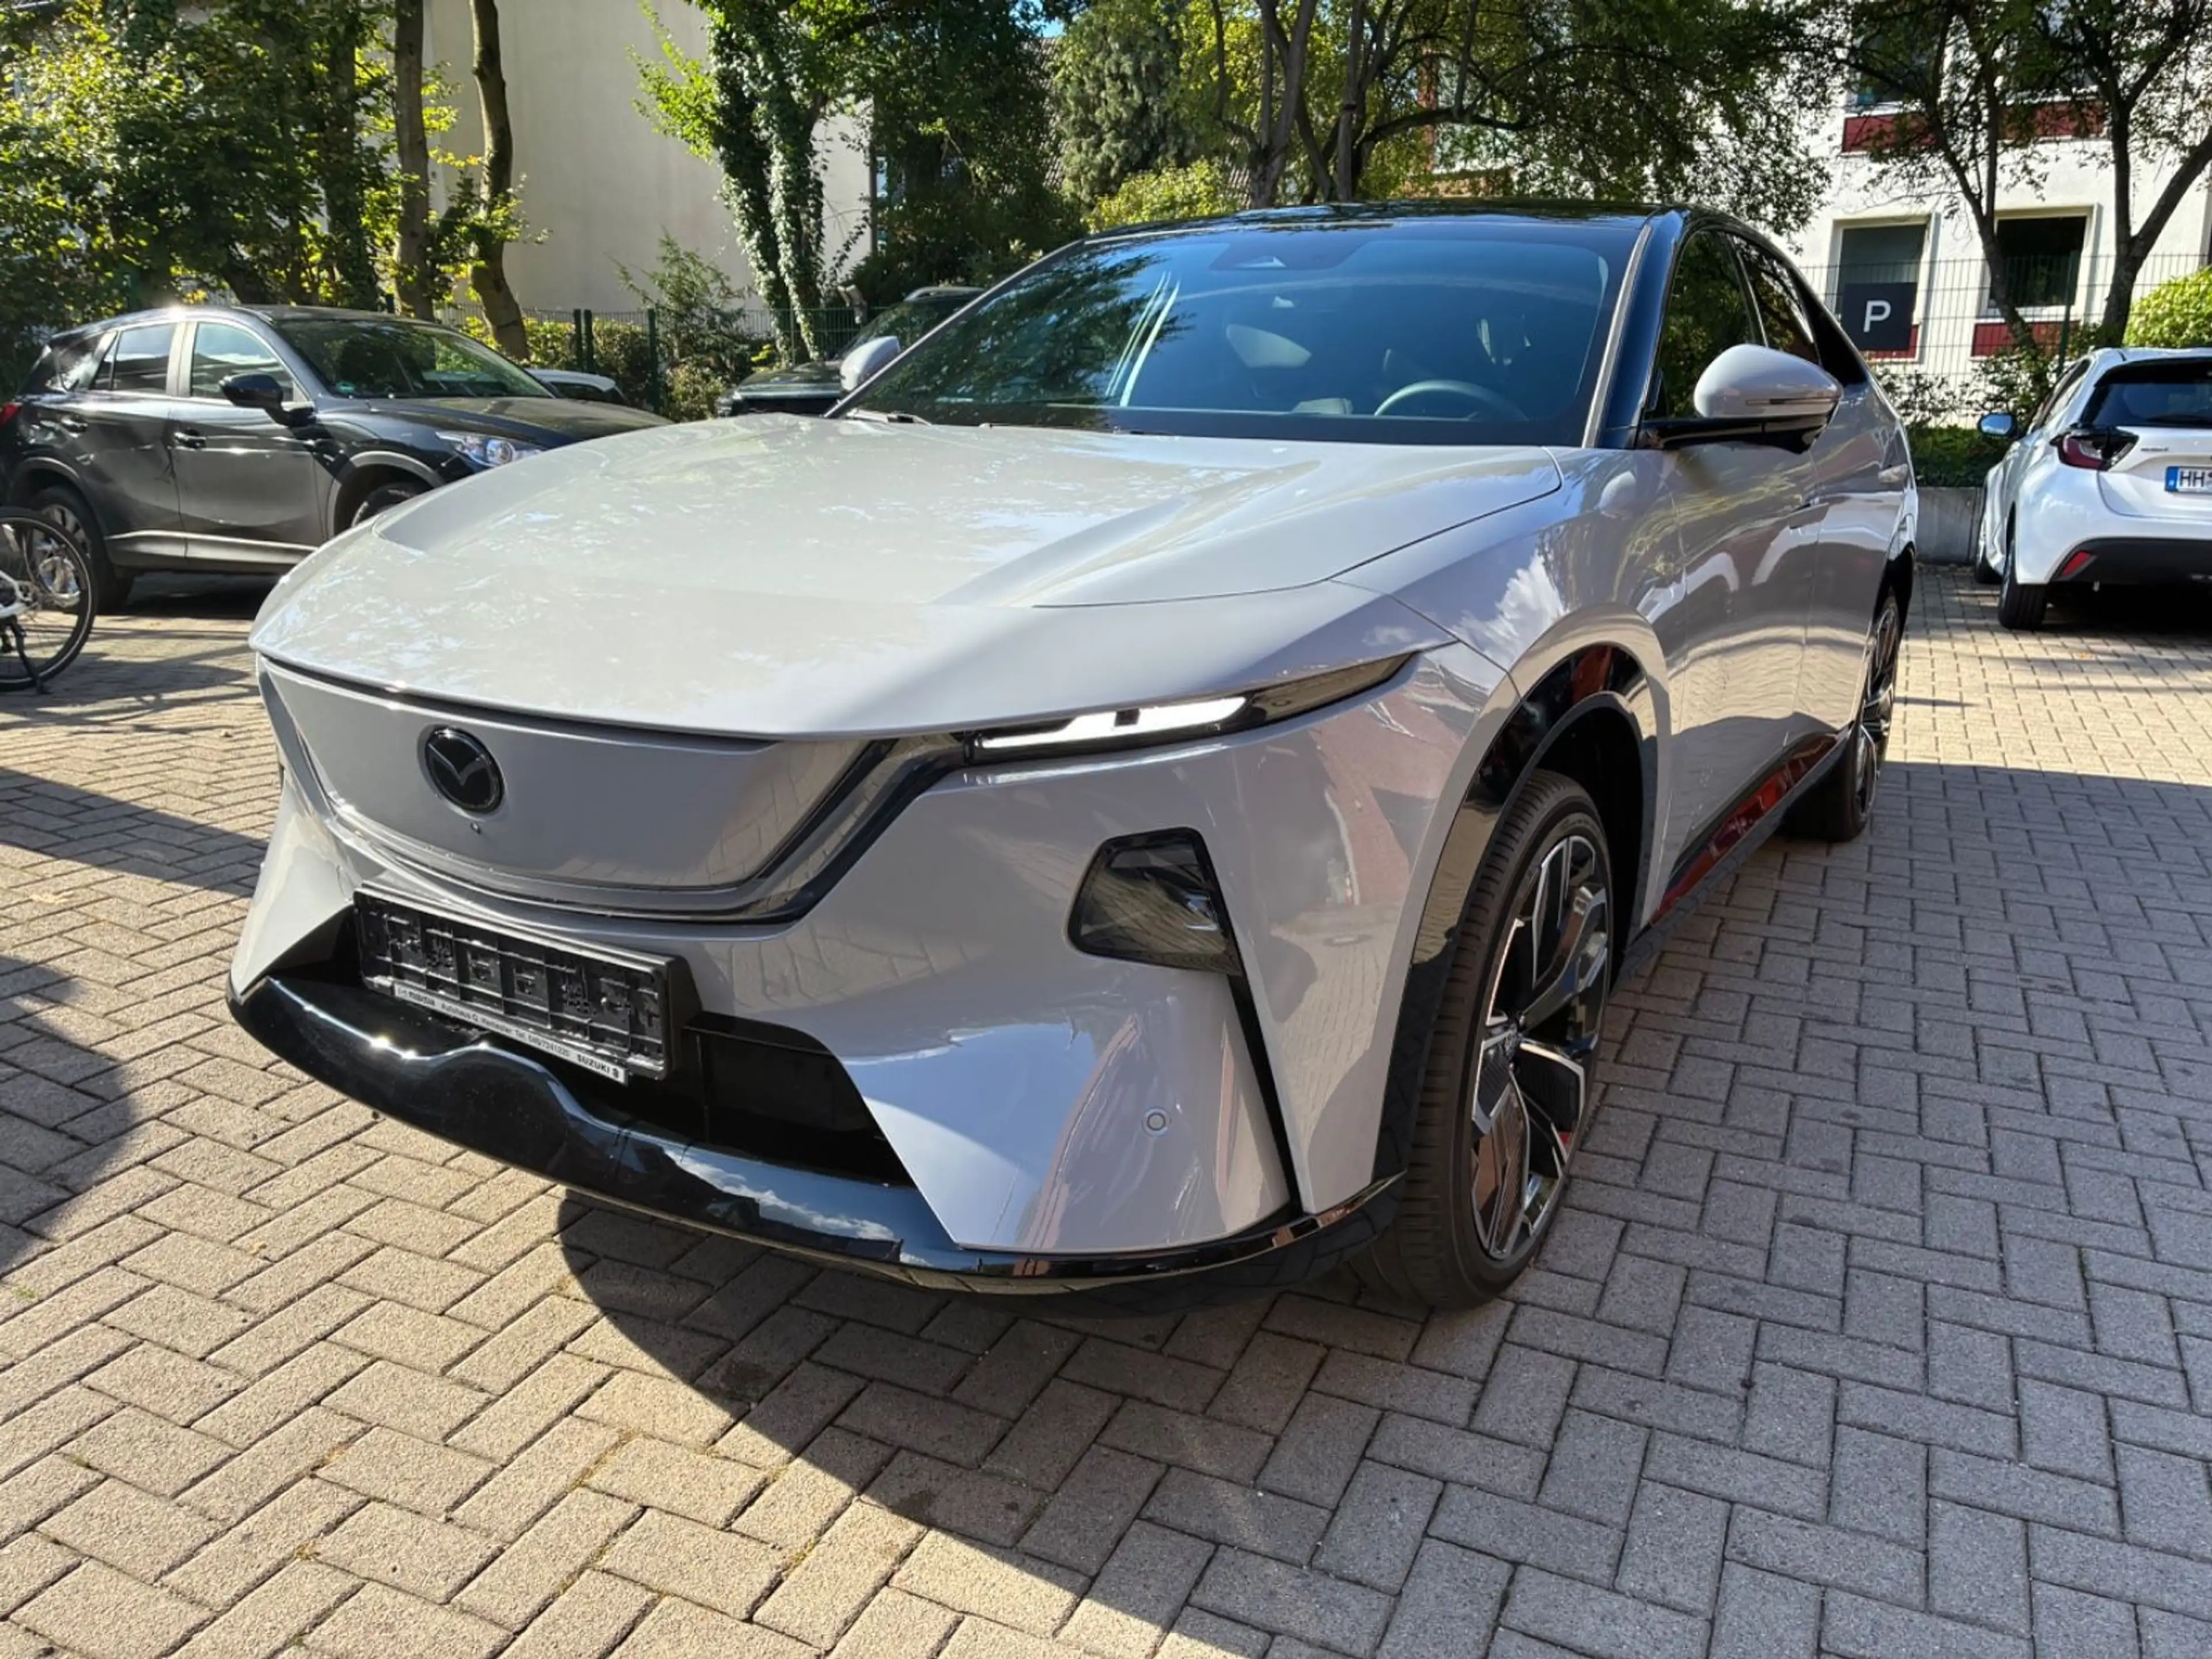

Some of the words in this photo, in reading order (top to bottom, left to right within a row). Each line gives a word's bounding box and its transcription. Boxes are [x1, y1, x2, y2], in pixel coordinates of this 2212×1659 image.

[1863, 300, 1891, 332] P
[2180, 471, 2205, 487] HH
[577, 1053, 610, 1074] SUZUKI
